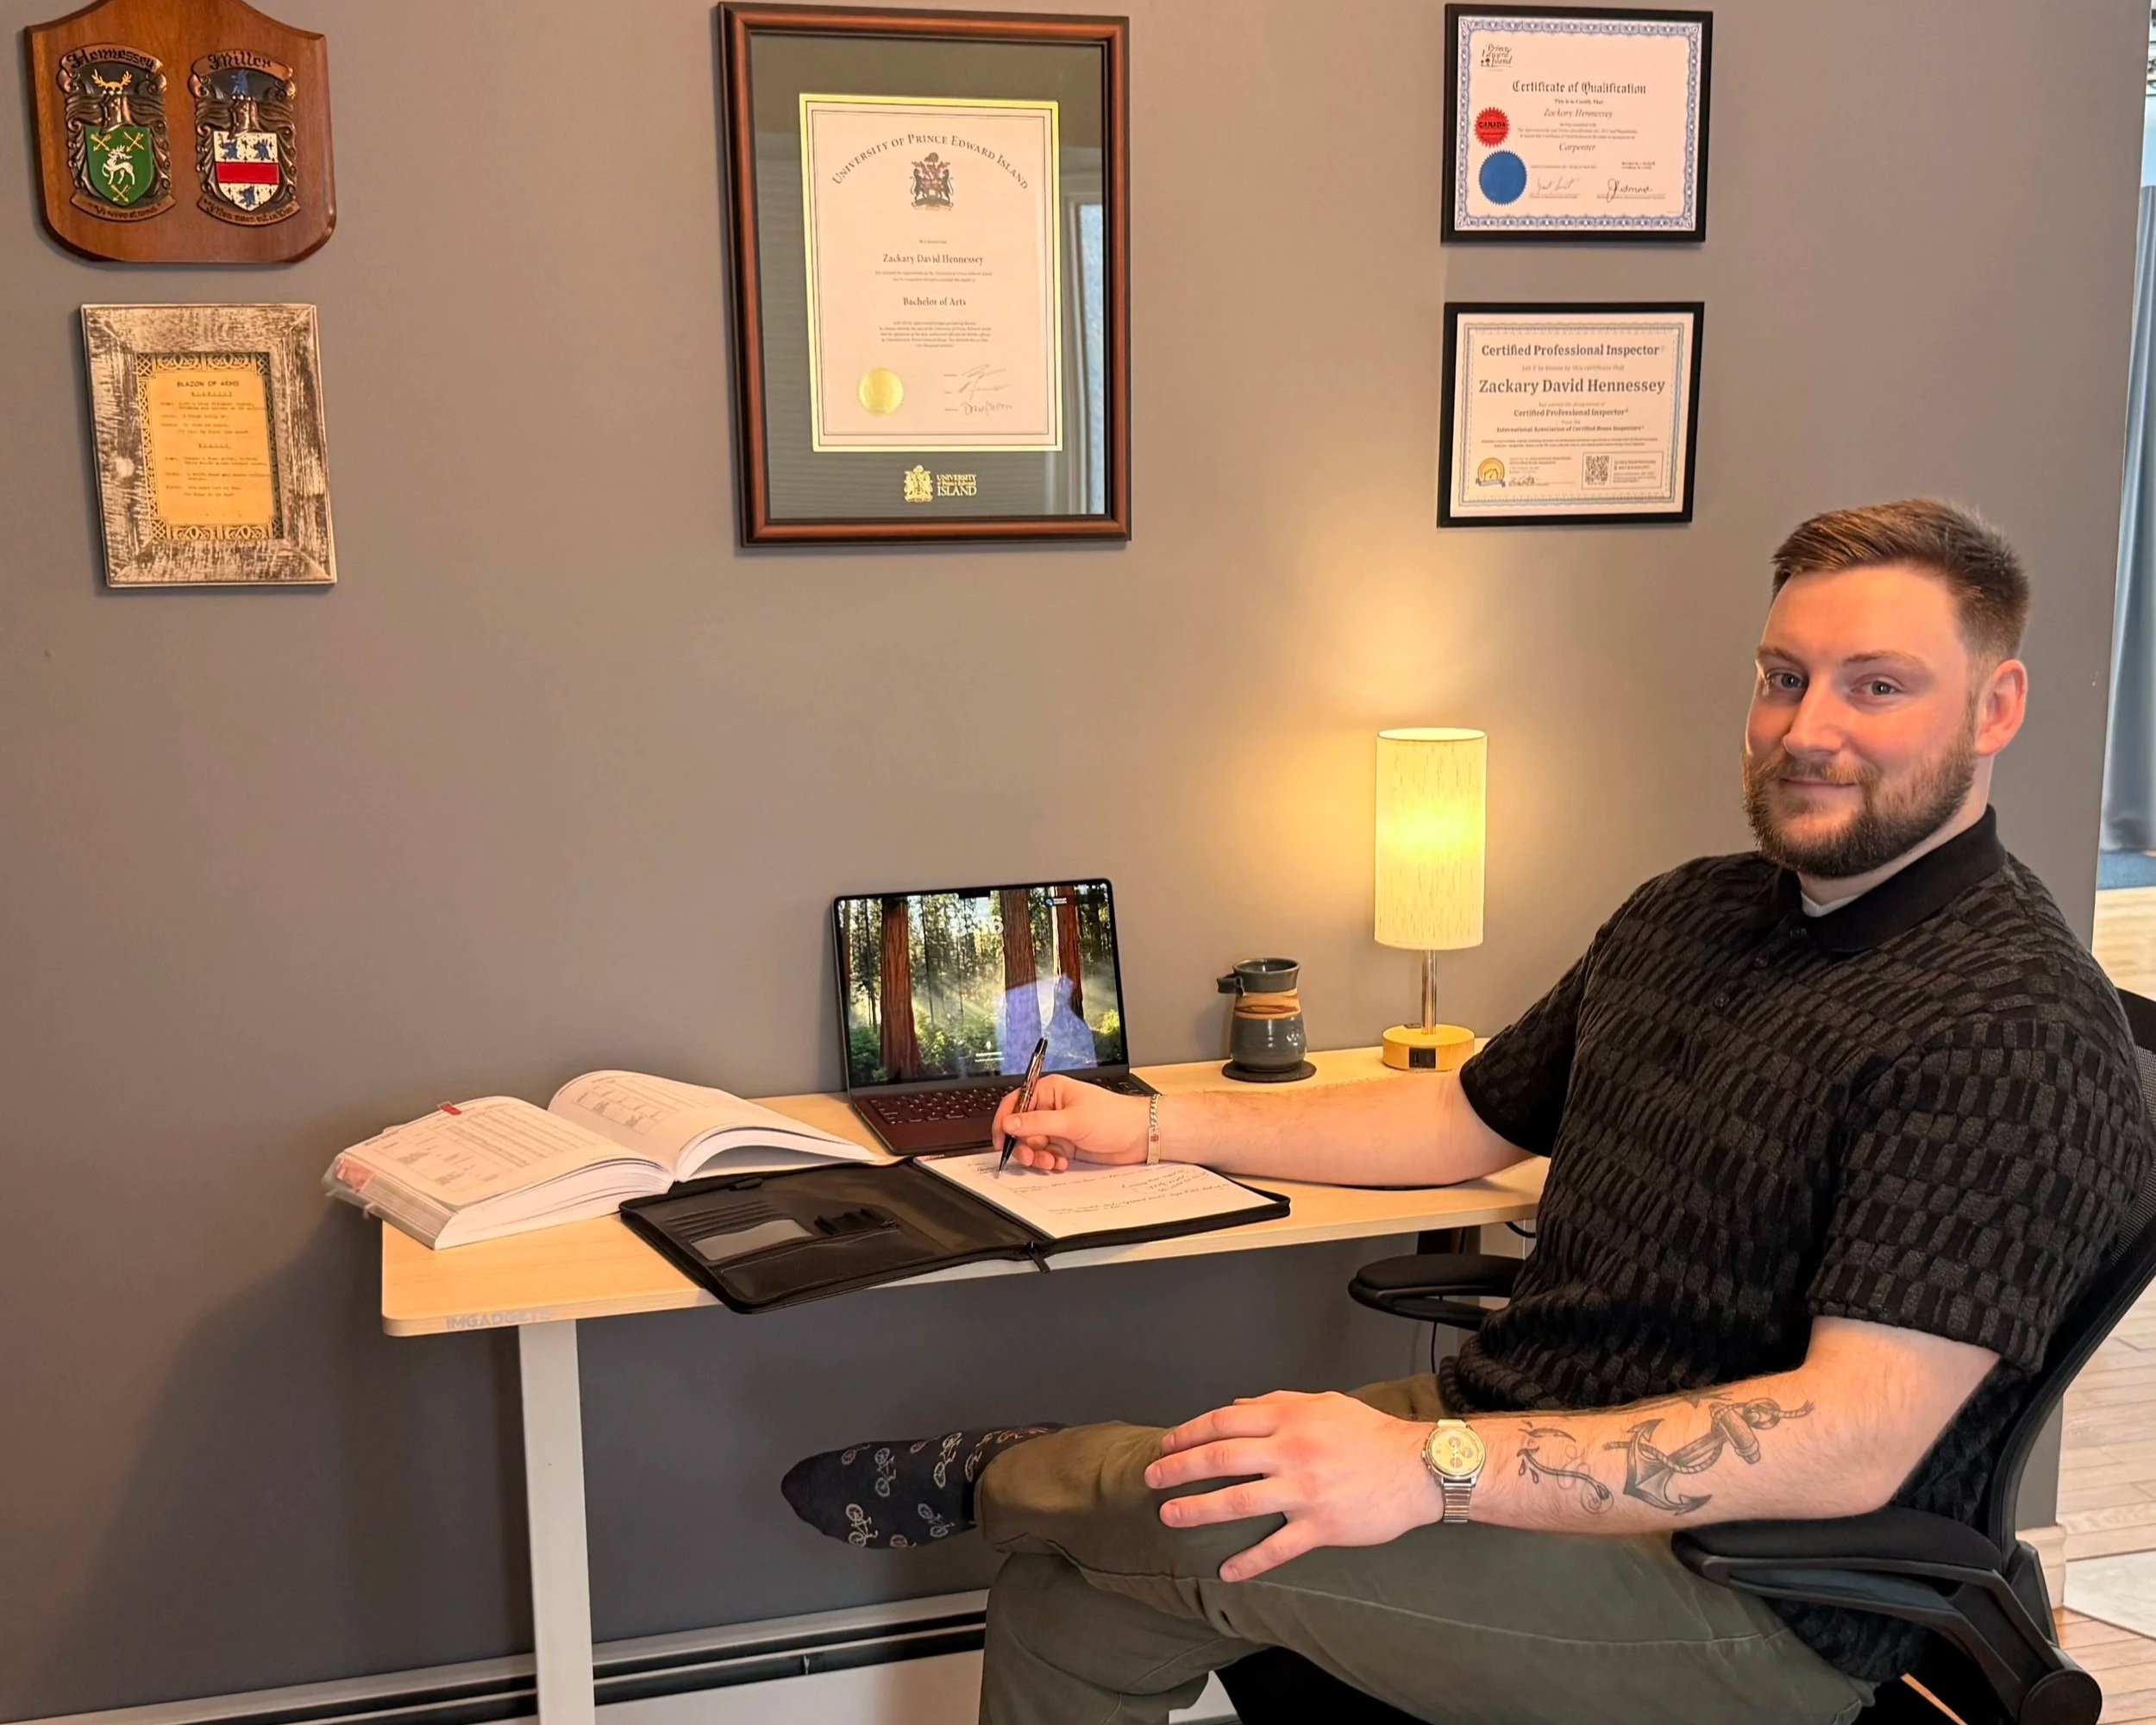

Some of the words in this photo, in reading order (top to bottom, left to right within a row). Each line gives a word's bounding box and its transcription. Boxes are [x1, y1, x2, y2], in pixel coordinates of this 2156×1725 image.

[207, 51, 272, 69] Miller
[1513, 80, 1565, 93] Certificate
[1568, 81, 1579, 93] of
[1581, 82, 1646, 95] Qualification
[1477, 121, 1507, 129] CANADA
[1559, 142, 1596, 154] Carpenter
[831, 141, 888, 185] UNIVERSITY
[883, 254, 915, 265] Zackary
[917, 254, 941, 263] David
[942, 254, 984, 266] Hennessey
[903, 297, 937, 306] Bachelor
[939, 297, 948, 306] of
[950, 298, 967, 306] Arts
[1482, 344, 1532, 356] Certified
[1533, 344, 1604, 356] Professional
[1479, 379, 1539, 396] Zackary
[1542, 378, 1583, 392] David
[1588, 379, 1665, 395] Hennessey
[1545, 409, 1590, 417] Professional
[937, 486, 977, 496] ISLAND
